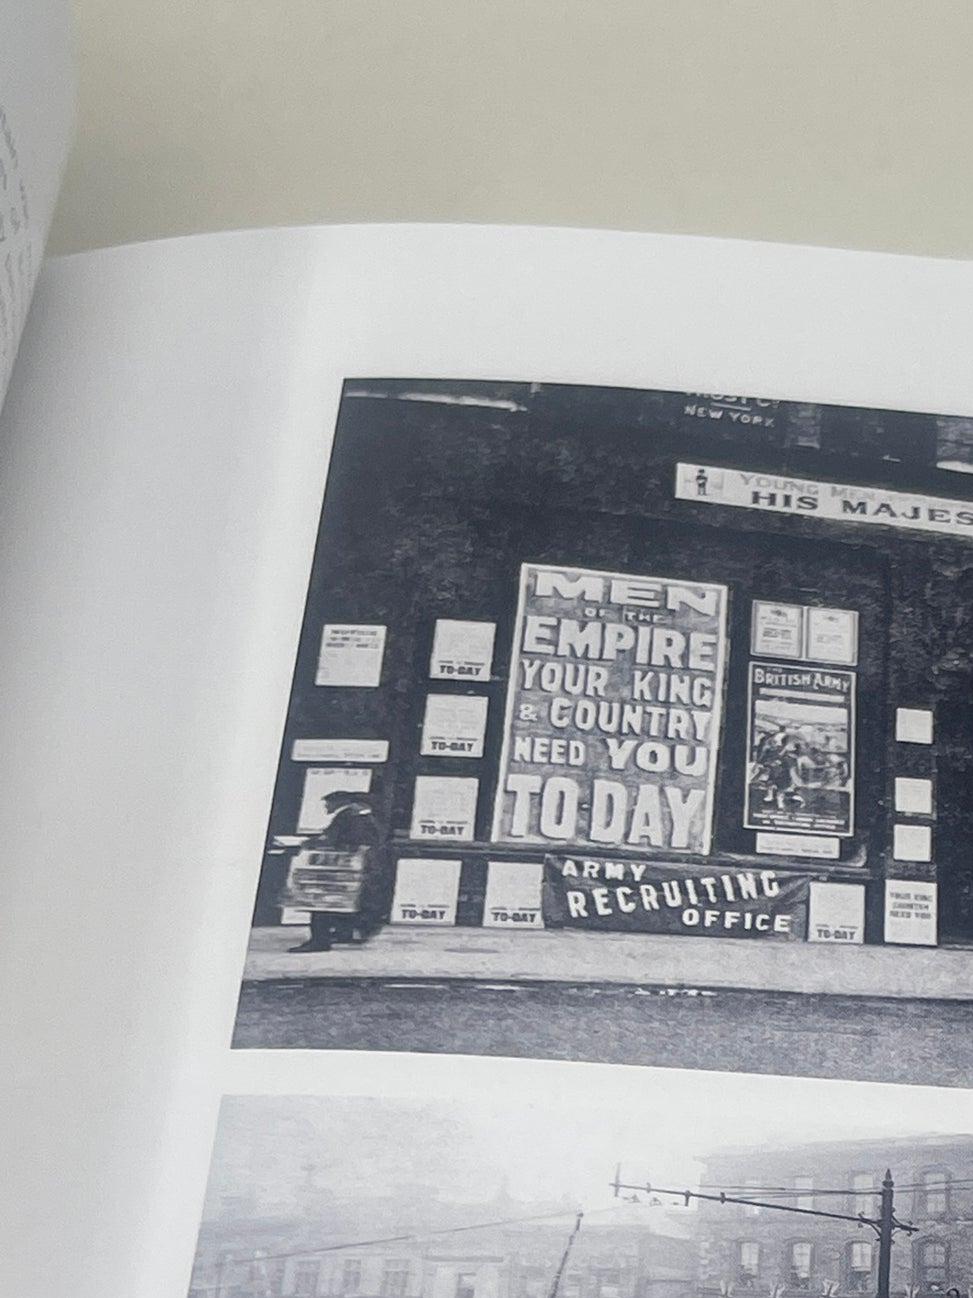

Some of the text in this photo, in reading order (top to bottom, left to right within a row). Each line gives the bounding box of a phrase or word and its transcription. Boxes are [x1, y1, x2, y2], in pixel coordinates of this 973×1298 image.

[684, 404, 775, 428] NEW YORK
[740, 474, 819, 495] YOUNG
[751, 490, 819, 510] HIS
[535, 570, 718, 617] MEN
[584, 607, 667, 623] OF THE
[522, 615, 717, 671] EMPIRE
[521, 659, 712, 707] YOUR KING
[754, 668, 850, 692] BRITISH ARMY
[519, 697, 712, 741] & COUNTRY
[513, 736, 707, 777] NEED YOU
[562, 859, 647, 882] ARMY
[566, 871, 781, 919] RECRUITING
[682, 908, 792, 933] OFFICE
